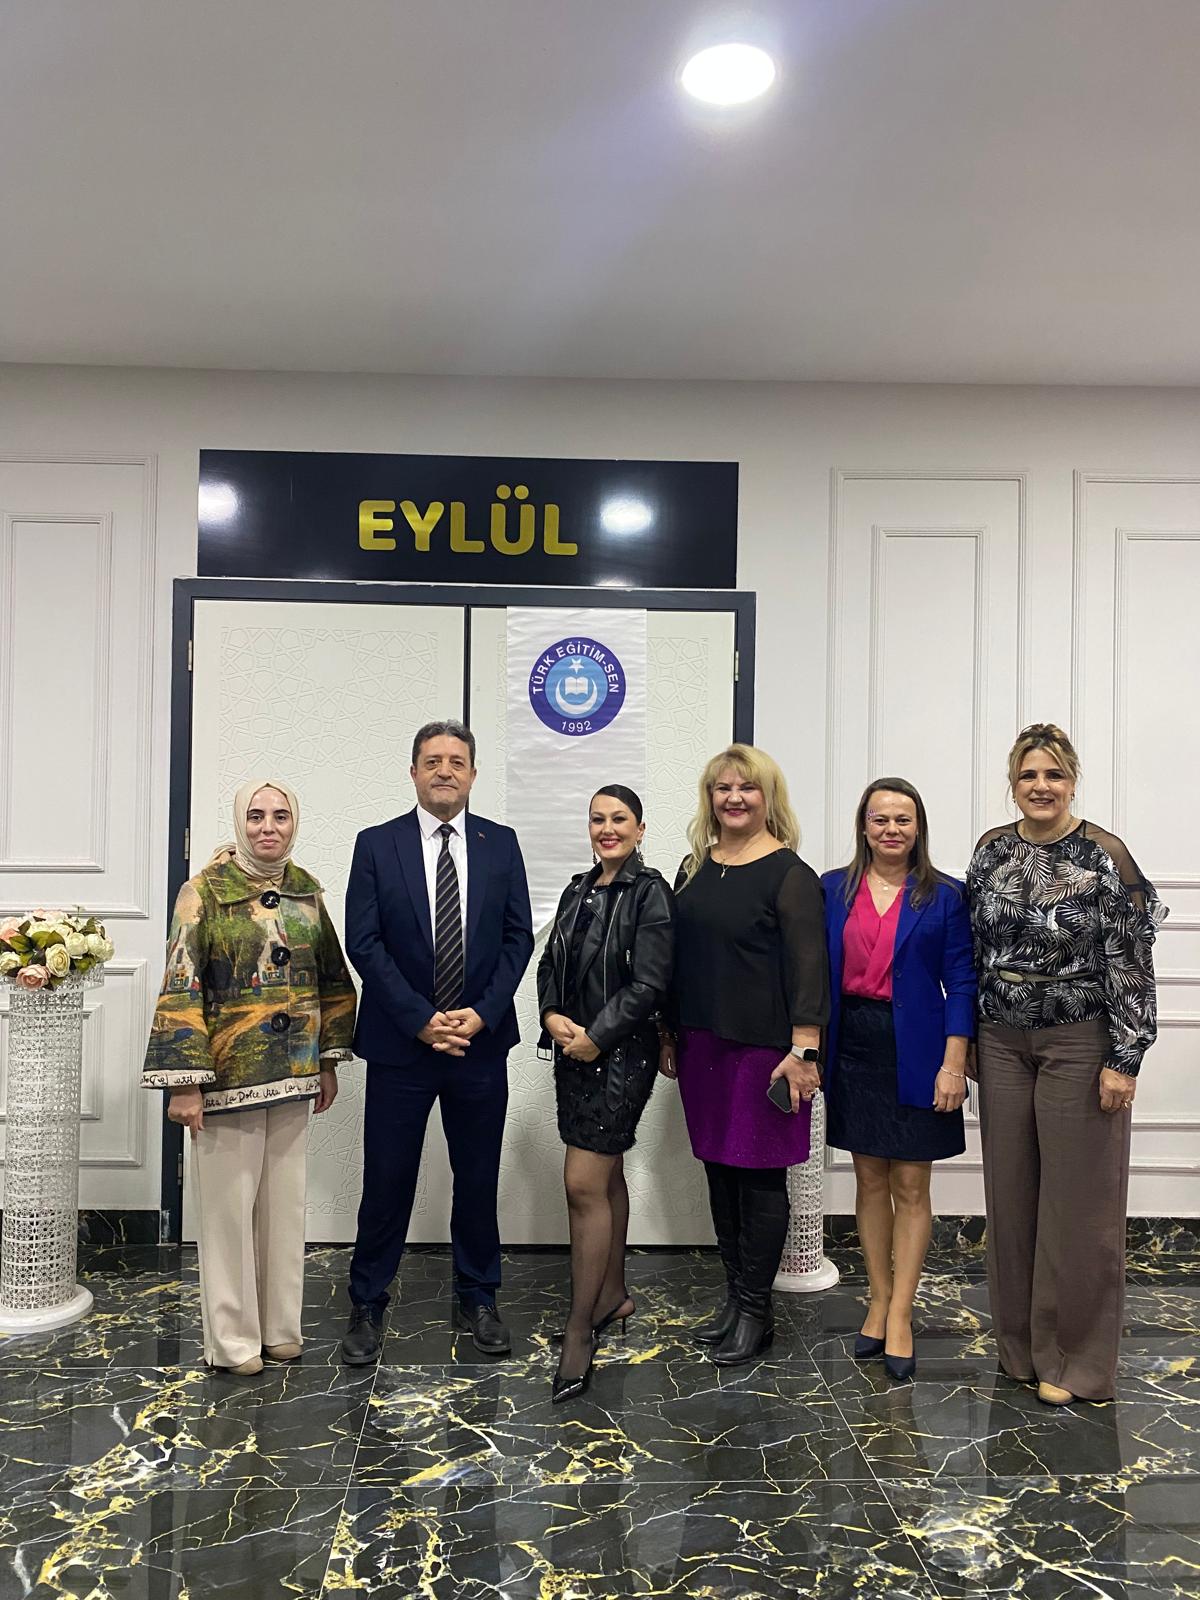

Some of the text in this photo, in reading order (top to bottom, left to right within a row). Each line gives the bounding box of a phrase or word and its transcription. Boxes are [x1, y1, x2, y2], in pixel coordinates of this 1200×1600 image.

[359, 484, 578, 555] EYLÜL
[531, 641, 620, 694] TÜRK EĞİTİM-SEN
[562, 720, 592, 733] 1992
